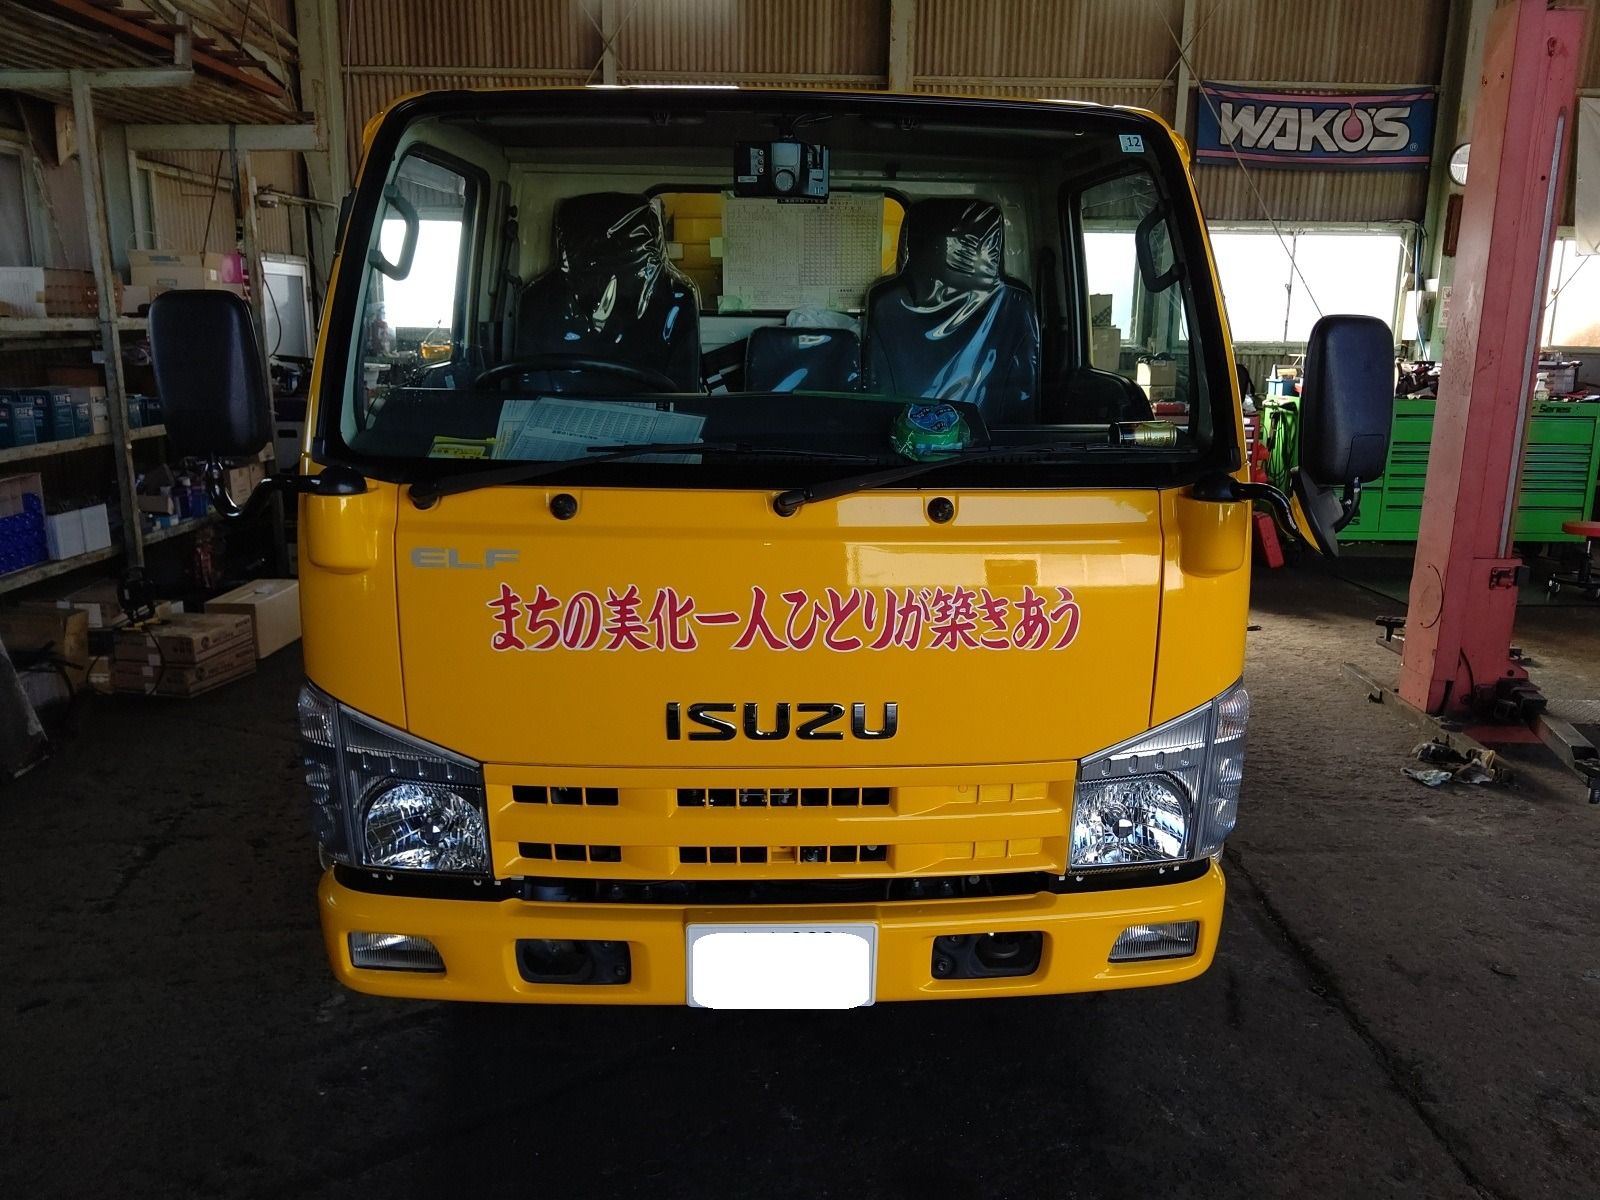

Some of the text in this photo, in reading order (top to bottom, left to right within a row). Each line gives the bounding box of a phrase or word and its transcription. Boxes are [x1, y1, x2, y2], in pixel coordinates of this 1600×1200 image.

[1126, 136, 1141, 147] 12
[1220, 102, 1411, 153] WAKO'S
[1538, 403, 1572, 413] Series
[411, 547, 521, 570] ELF
[486, 582, 1081, 652] まちの美化一人ひとりが築きあう
[665, 702, 899, 741] ISUZU
